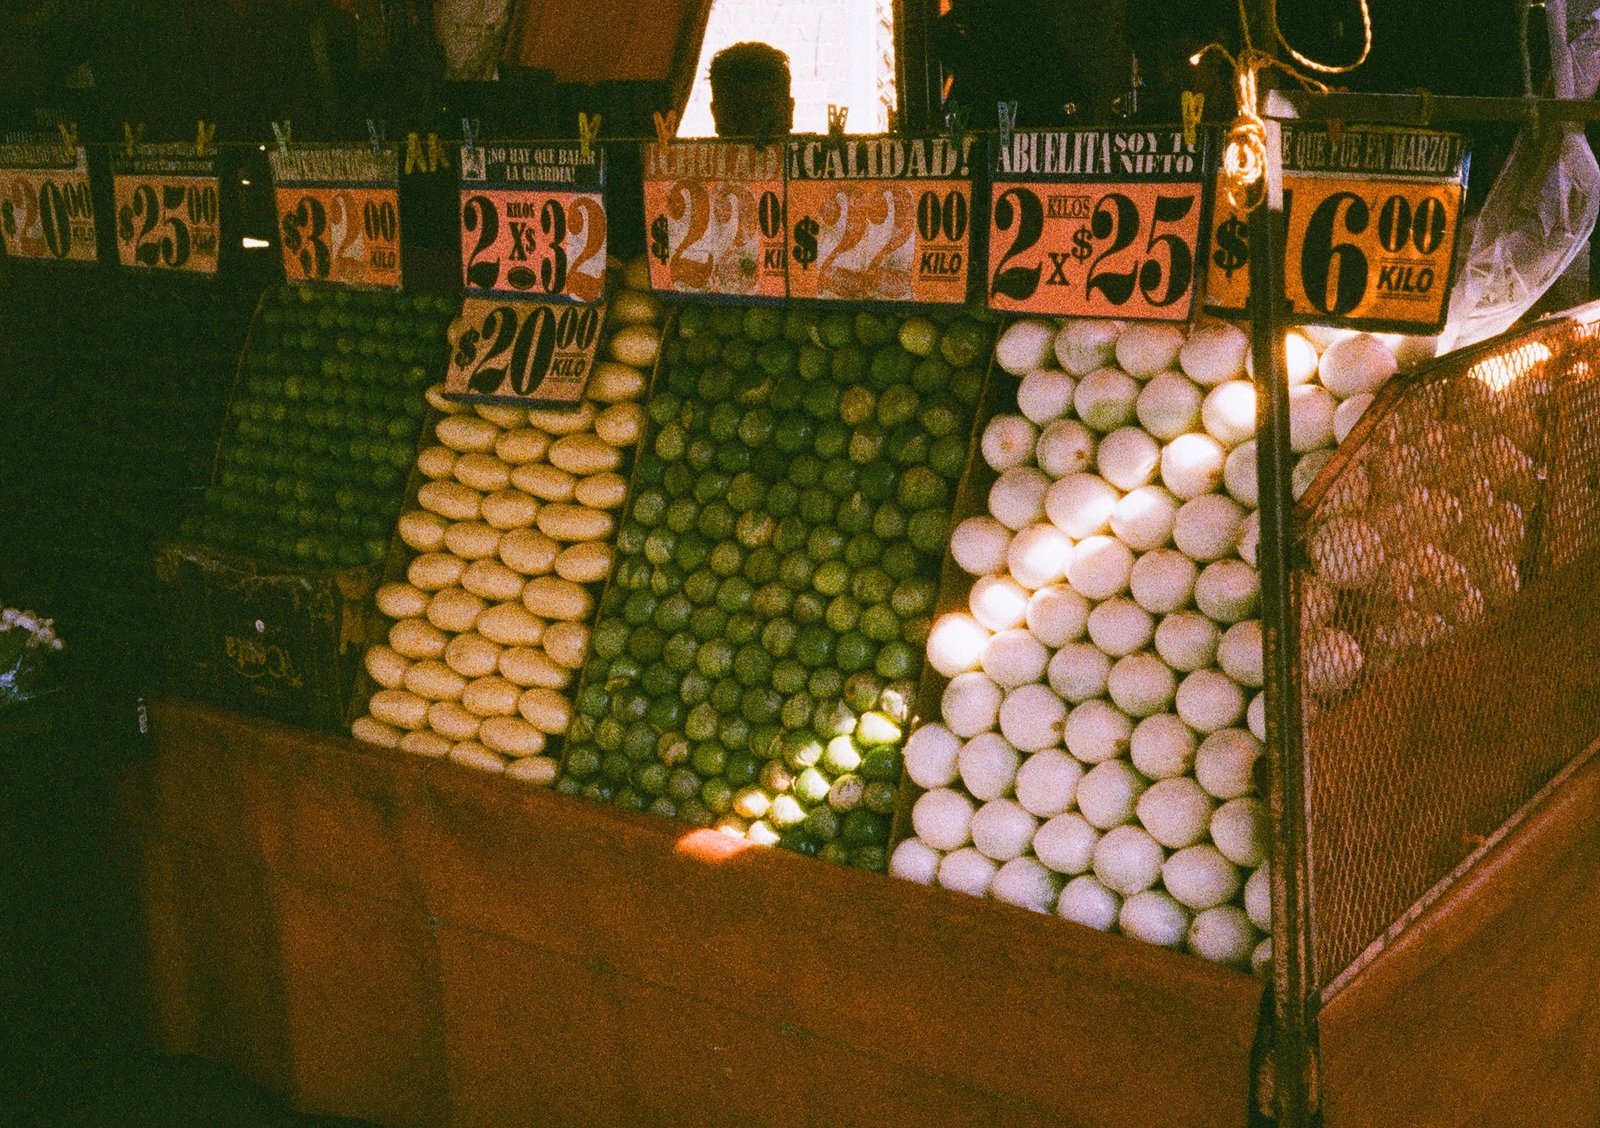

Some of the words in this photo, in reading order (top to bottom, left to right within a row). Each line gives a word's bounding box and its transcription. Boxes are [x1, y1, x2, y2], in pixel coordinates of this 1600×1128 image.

[509, 148, 530, 163] HAY
[534, 148, 556, 165] QUE
[789, 135, 975, 179] ¡CALIDAD!
[996, 132, 1111, 174] ABUELITA
[1113, 132, 1162, 153] SOY
[1296, 131, 1327, 169] QUE
[1364, 133, 1387, 170] EN
[1119, 154, 1194, 174] NIETO
[118, 184, 190, 266] $25
[363, 200, 396, 242] 00
[917, 191, 968, 242] 00
[1047, 197, 1091, 218] KILOS
[1378, 195, 1448, 255] 00
[463, 195, 500, 289] 2
[763, 249, 783, 269] KI
[918, 251, 962, 275] KILO
[991, 187, 1044, 300] 2
[1377, 264, 1436, 292] KILO
[453, 306, 557, 397] $20
[556, 306, 599, 350] 00
